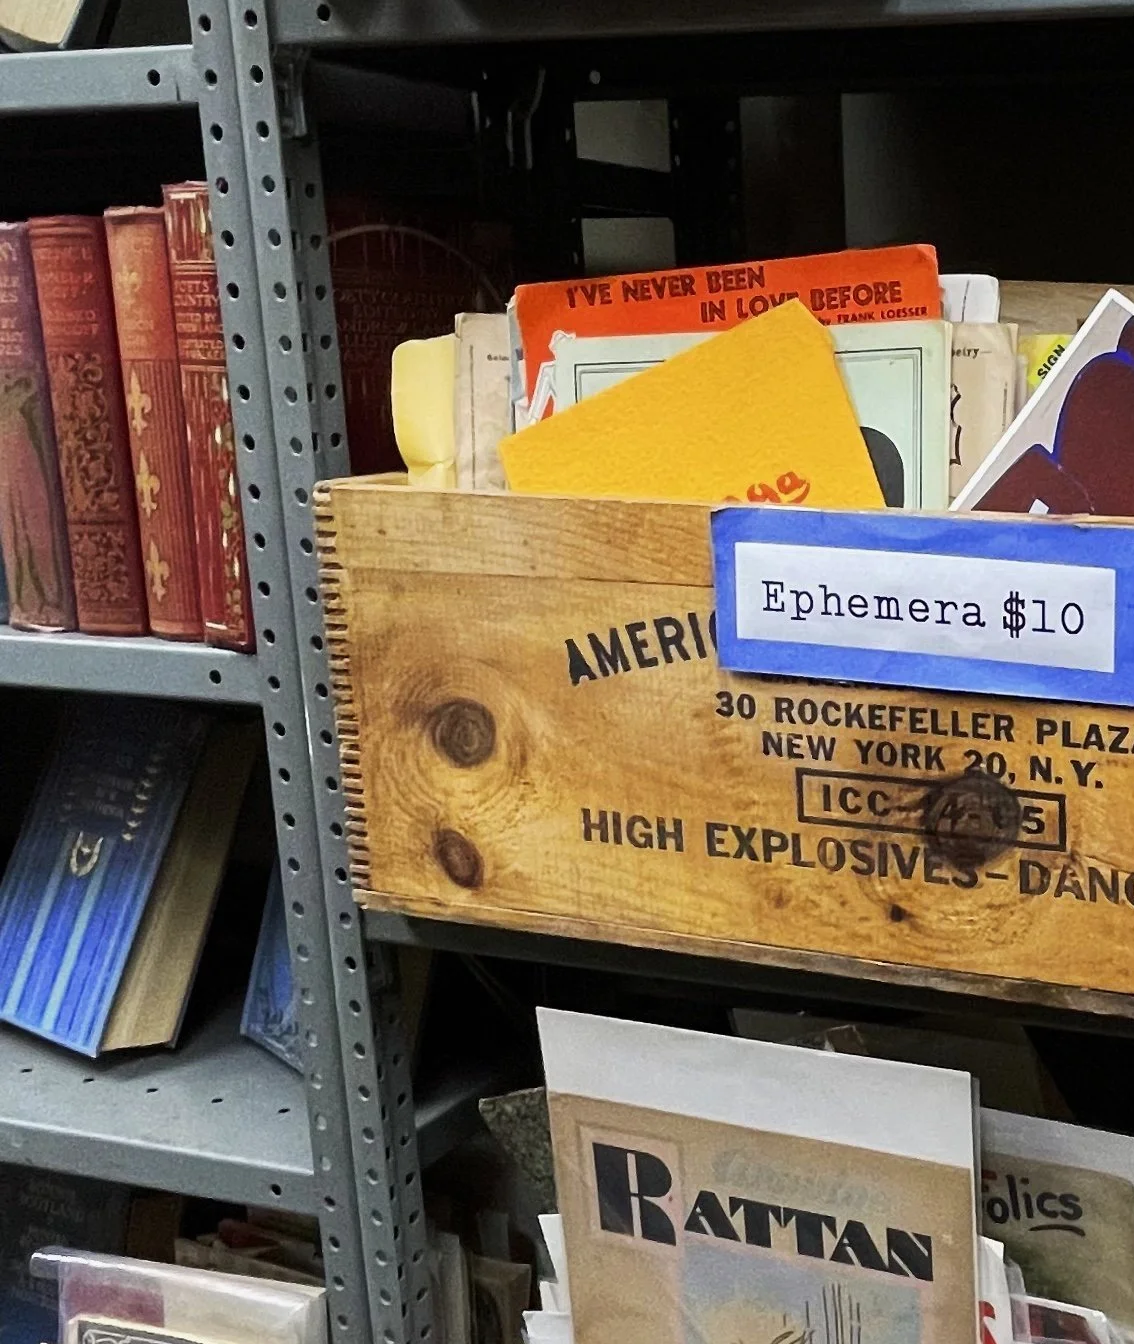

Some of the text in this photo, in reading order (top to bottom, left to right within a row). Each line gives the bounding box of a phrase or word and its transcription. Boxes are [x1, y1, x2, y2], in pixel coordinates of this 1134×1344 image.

[566, 265, 766, 309] I'VE NEVER BEEN
[700, 279, 902, 324] IN BEFORE
[836, 305, 929, 324] FRANK LOESSER
[1036, 344, 1065, 380] SIGN
[761, 579, 1085, 639] Ephemera $10
[714, 690, 757, 720] 30
[773, 696, 1016, 743] ROCKEFELLER
[761, 730, 946, 772] NEW YORK
[581, 807, 686, 853] HIGH
[592, 1141, 934, 1282] RATTAN
